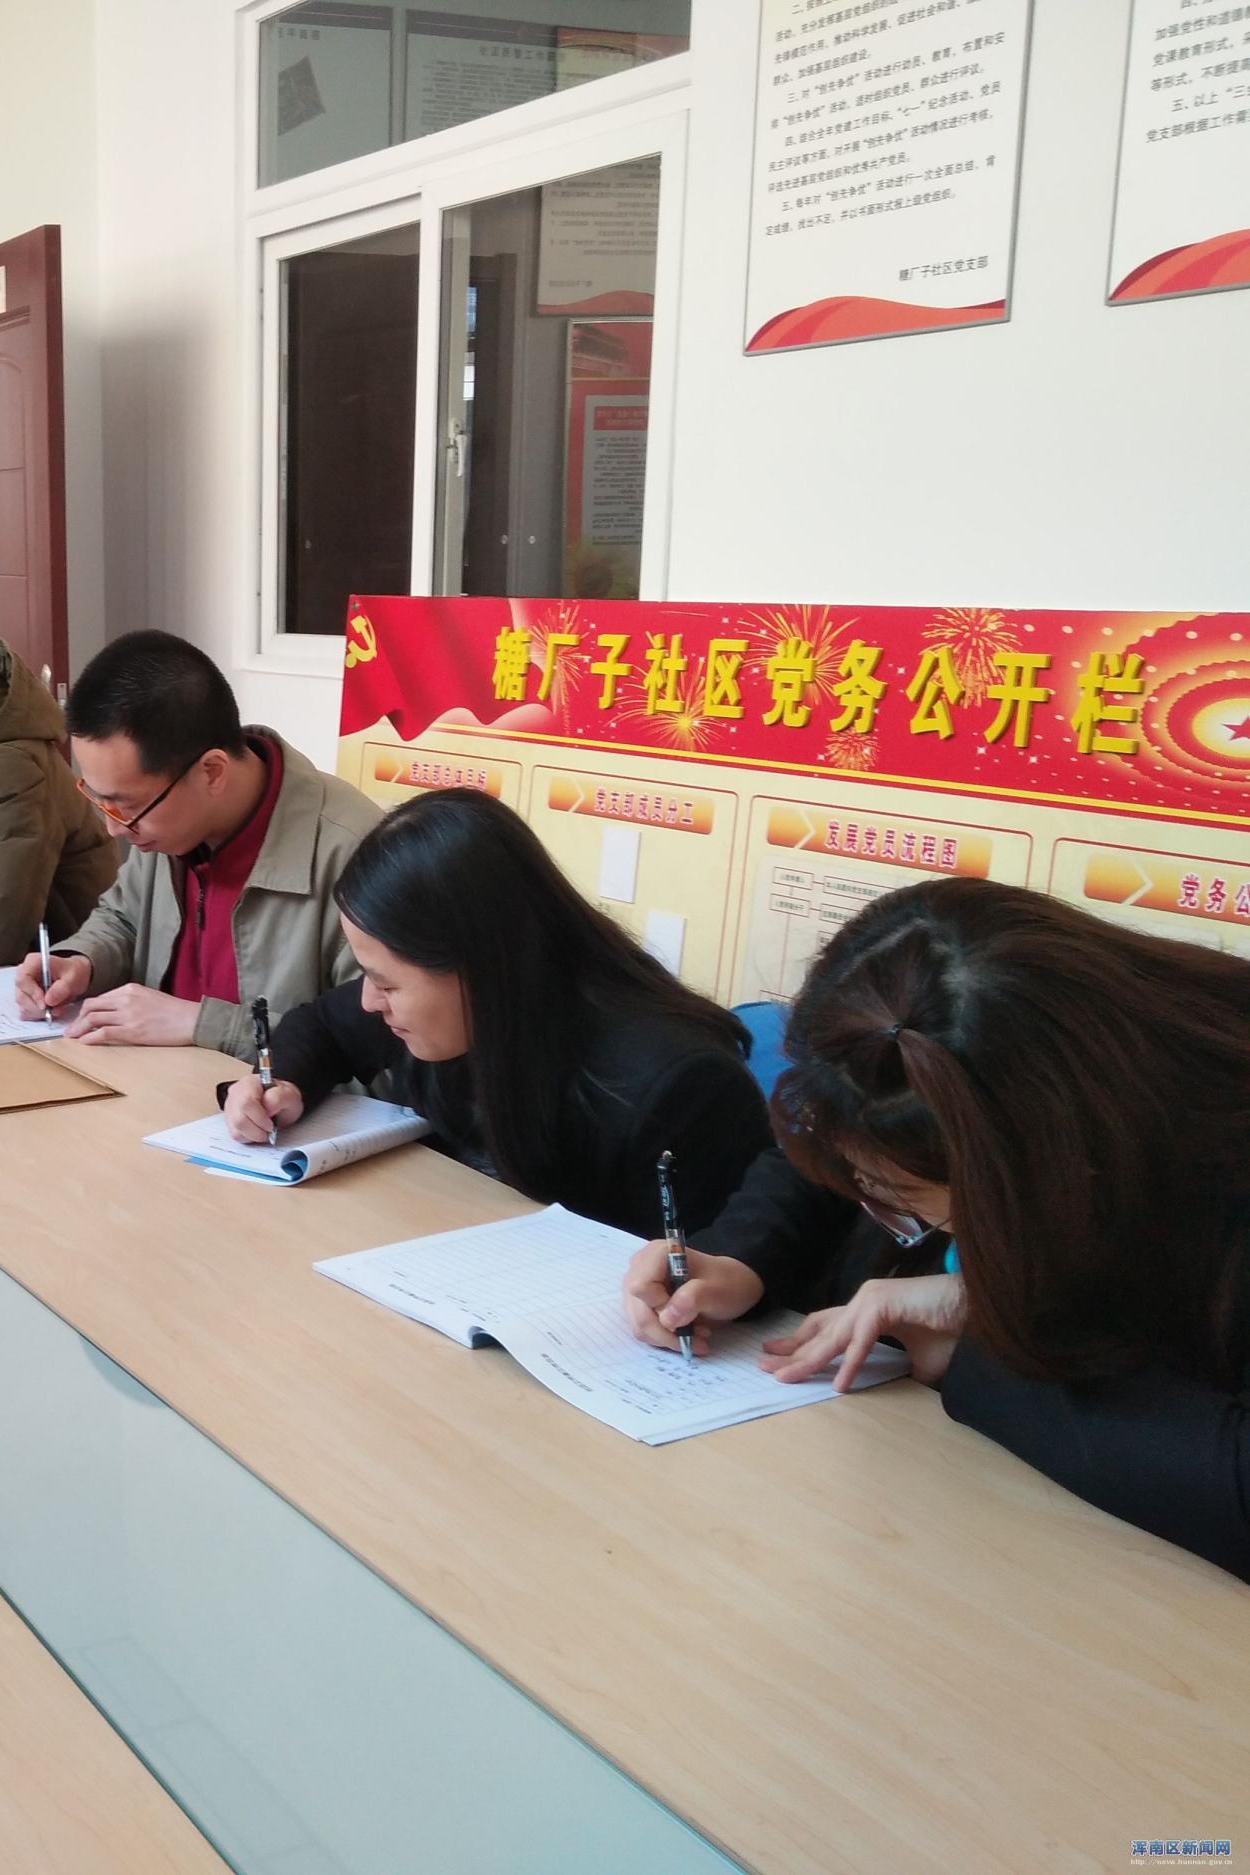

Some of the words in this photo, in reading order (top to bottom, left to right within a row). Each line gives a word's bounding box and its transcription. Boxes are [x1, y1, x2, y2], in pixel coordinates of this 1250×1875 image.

[898, 255, 990, 282] 糖厂子社区党支部
[491, 625, 1147, 756] 糖厂子社区党务公开栏
[594, 786, 695, 826] 党支部成员分工
[824, 818, 959, 870] 发展党员流程图
